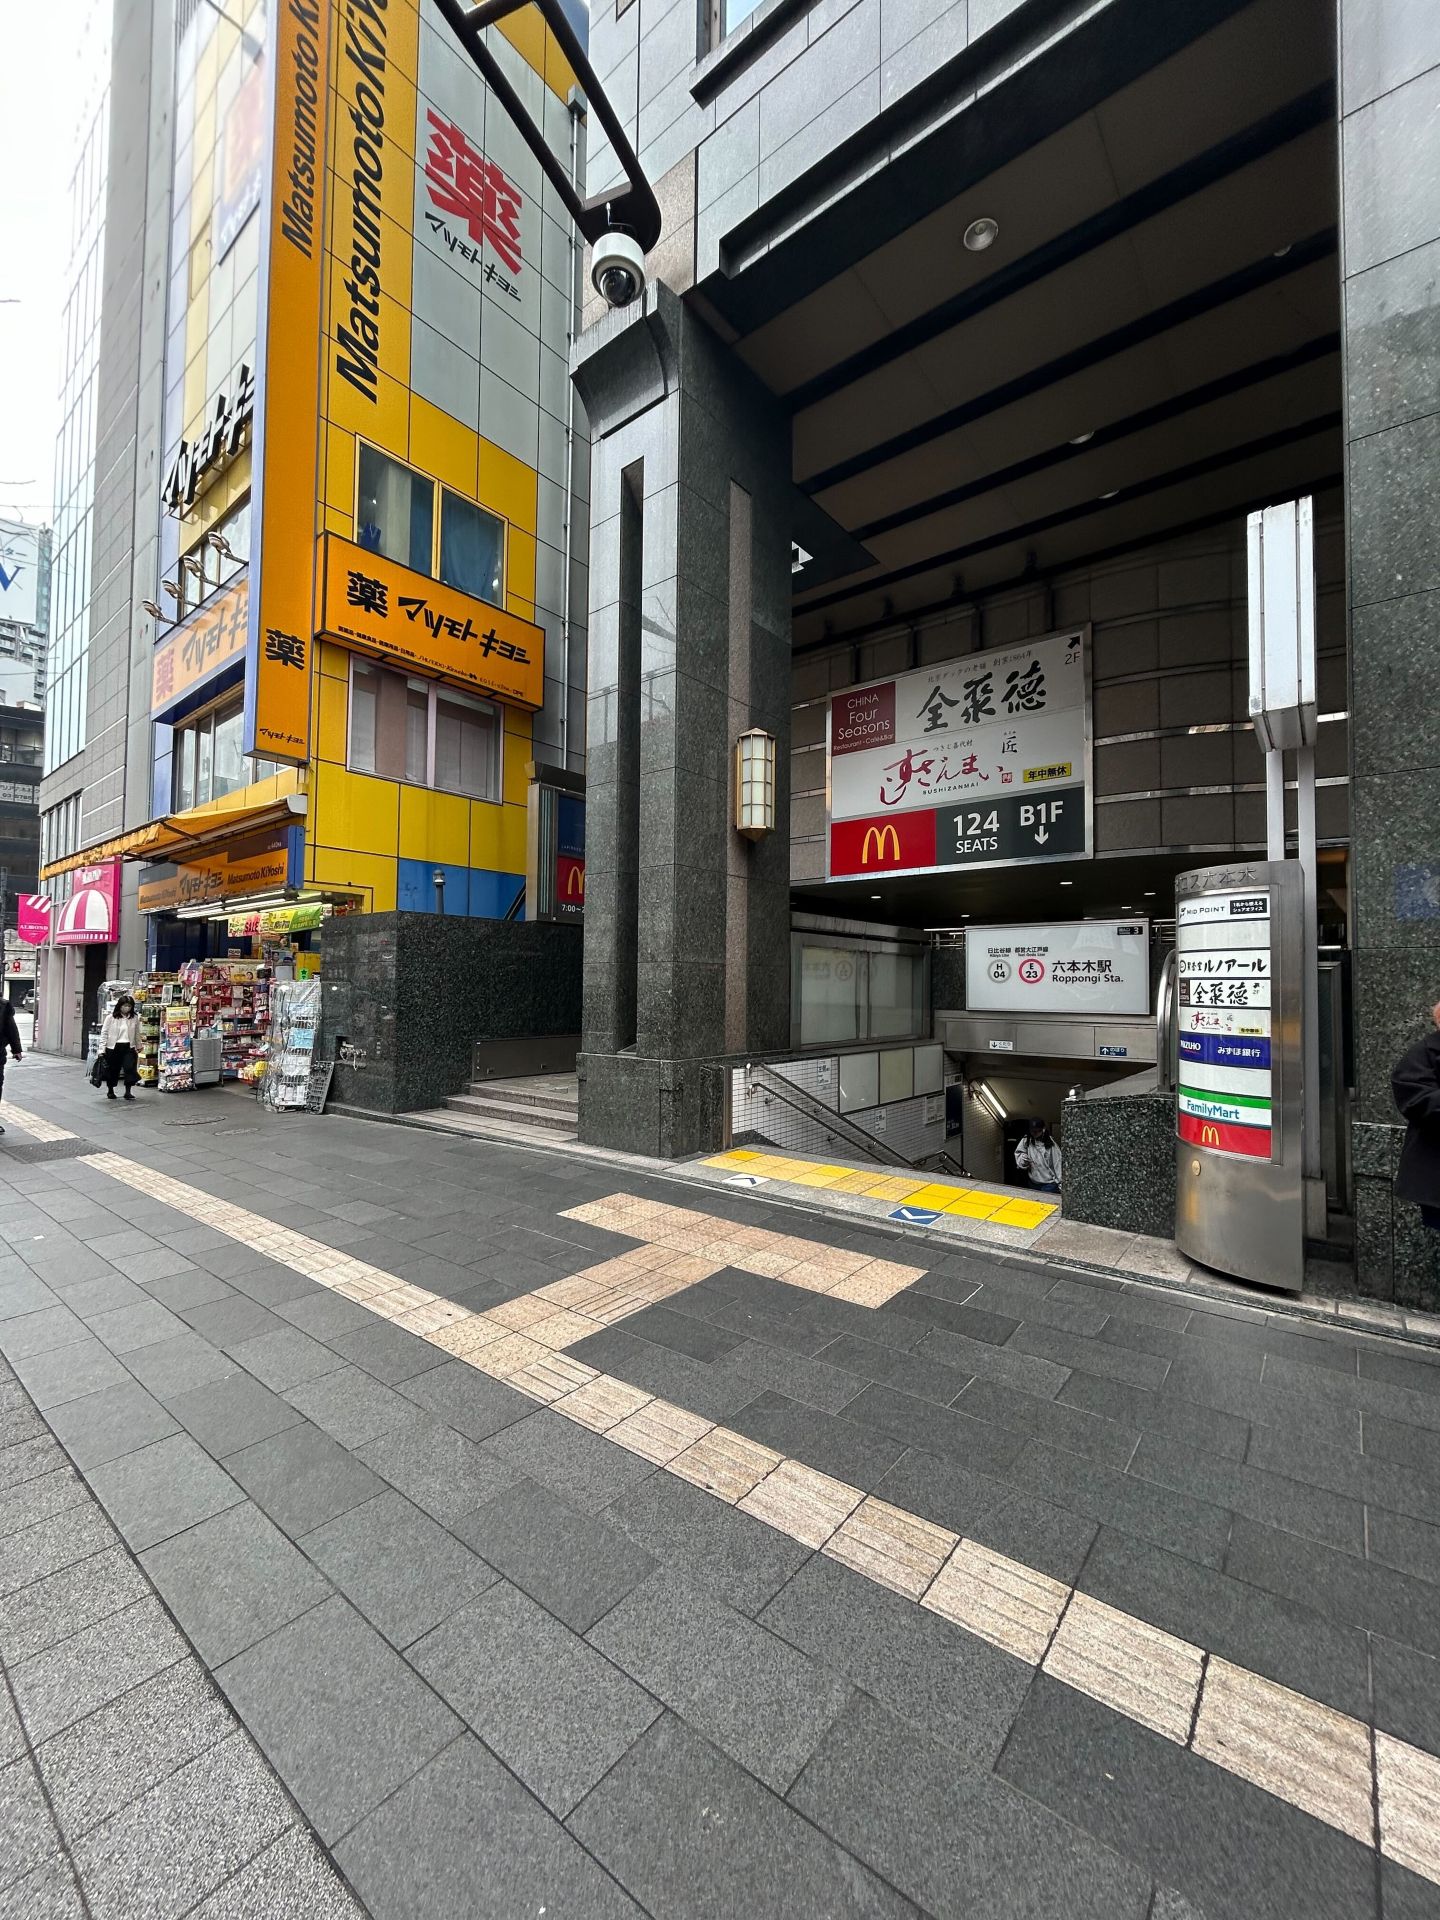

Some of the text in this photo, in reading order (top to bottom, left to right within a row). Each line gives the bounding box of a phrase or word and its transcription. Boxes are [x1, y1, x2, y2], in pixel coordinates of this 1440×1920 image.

[424, 107, 523, 276] 薬
[424, 211, 522, 303] マツモトキヨシ
[347, 570, 531, 665] 薬 マツモトキヨシ
[182, 592, 248, 673] マツモトキ
[265, 627, 306, 671] 薬
[1064, 651, 1081, 665] 2F
[847, 693, 879, 709] CHINA
[849, 709, 879, 725] Four
[259, 728, 306, 745] マツモトキヨシ
[838, 720, 890, 740] Seasons
[1028, 765, 1067, 780] 年中無休
[922, 781, 979, 795] SUSHIZANMAI
[1020, 801, 1064, 827] B1F
[953, 810, 1000, 837] 124
[956, 837, 999, 854] SEATS
[1199, 906, 1226, 914] POINT
[1133, 926, 1140, 935] 3
[996, 963, 1003, 971] H
[1029, 962, 1035, 970] E
[1052, 960, 1112, 974] 六本木駅
[993, 970, 1006, 979] 04
[1025, 970, 1038, 979] 23
[1052, 973, 1124, 985] Roppongi Sta.
[1217, 1046, 1261, 1058] みずほ銀行
[1187, 1100, 1240, 1120] FamilyMart
